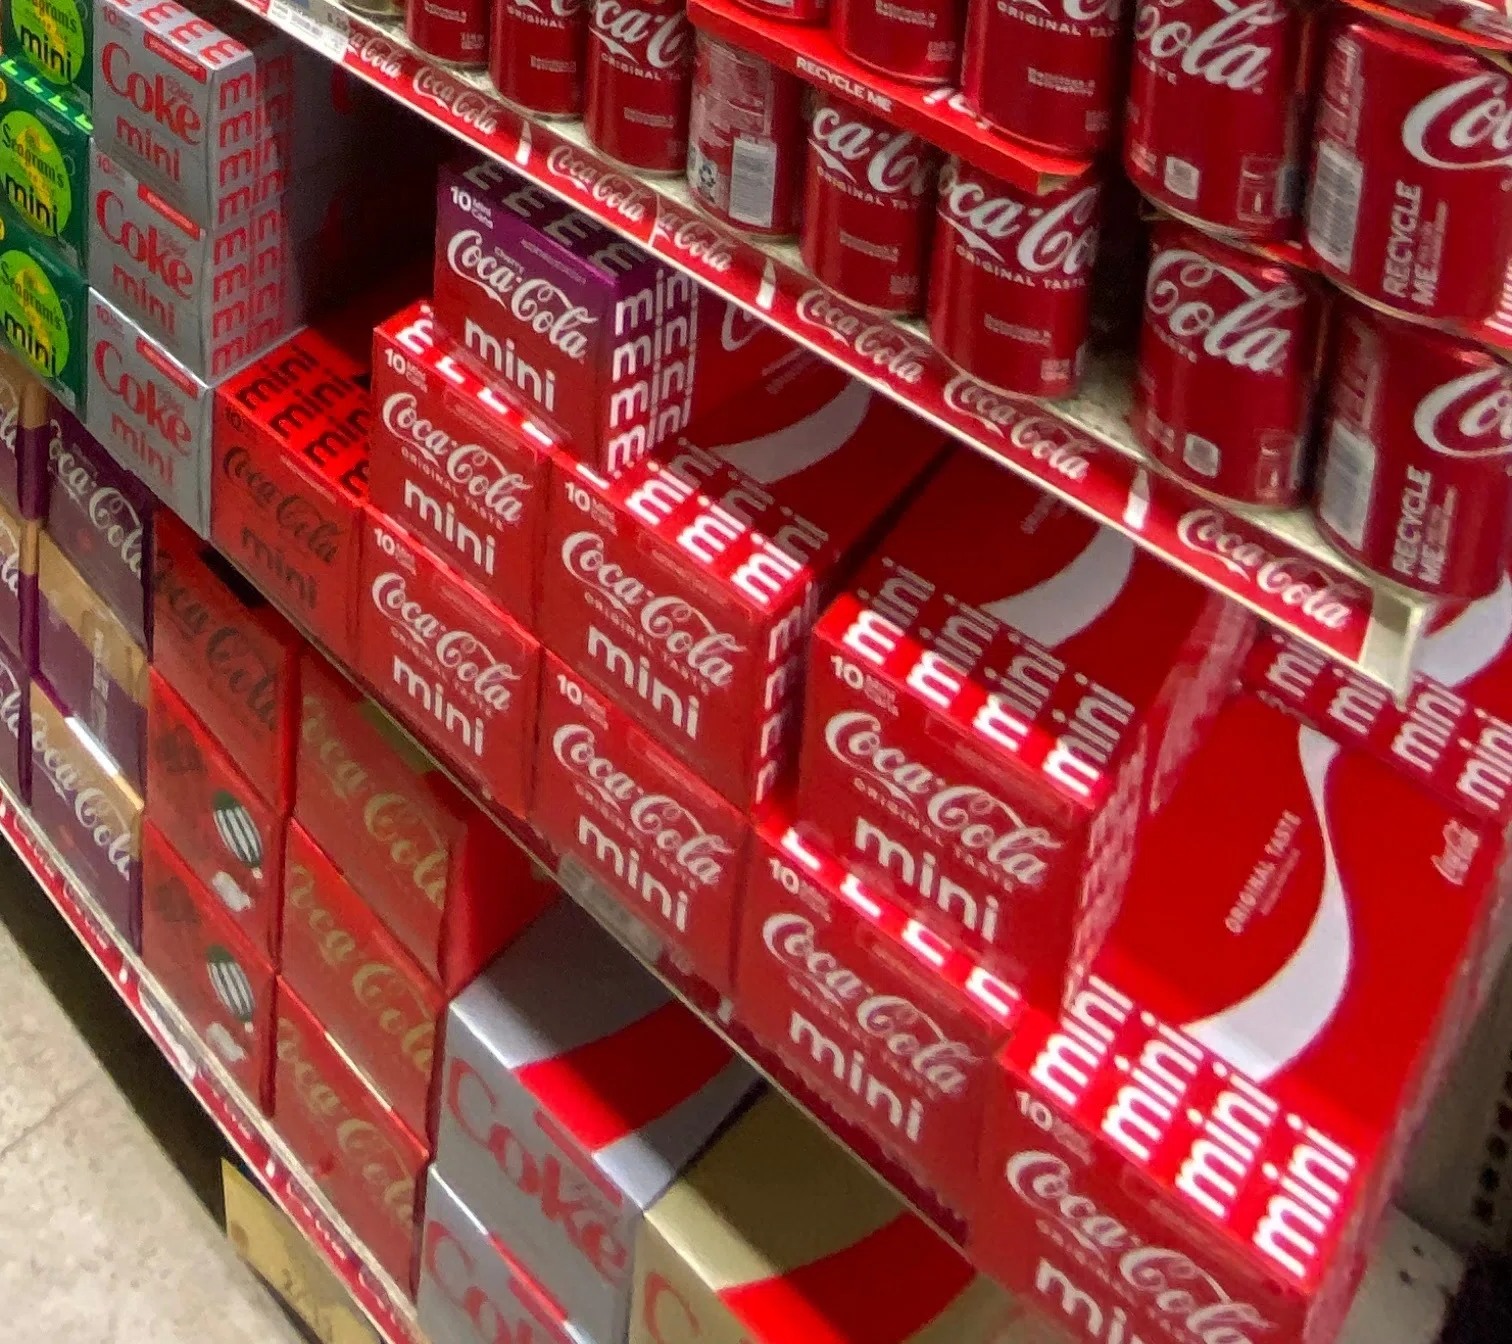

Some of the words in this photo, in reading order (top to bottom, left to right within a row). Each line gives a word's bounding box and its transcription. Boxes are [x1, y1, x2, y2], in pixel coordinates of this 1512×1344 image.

[19, 23, 73, 84] mini
[996, 0, 1083, 37] ORIGINAL
[101, 41, 203, 146] Coke
[794, 55, 866, 103] RECYCLE
[867, 90, 893, 112] ME
[115, 113, 181, 183] mini
[450, 186, 471, 213] 10
[5, 175, 60, 238] mini
[95, 188, 195, 301] Coke
[1383, 178, 1422, 299] RECYCLE
[4, 310, 58, 378] mini
[111, 262, 177, 337] mini
[447, 228, 598, 362] Coca-Cola
[94, 339, 194, 449] Coke
[384, 347, 407, 376] 10
[464, 316, 556, 413] mini
[382, 391, 532, 523] Coca-Cola
[564, 480, 591, 513] 10
[374, 527, 395, 555] 10
[404, 478, 497, 577] mini
[1392, 464, 1432, 575] RECYCLE
[371, 571, 521, 713] Coca-Cola
[561, 530, 748, 689] Coca-Cola
[393, 654, 485, 758] mini
[557, 673, 585, 707] 10
[587, 624, 700, 742] mini
[829, 655, 863, 690] 10
[552, 723, 736, 887] Coca-Cola
[825, 712, 1063, 888] Coca-Cola
[577, 815, 688, 934] mini
[768, 857, 801, 894] 10
[854, 816, 1000, 946] mini
[761, 913, 986, 1096] Coca-Cola
[1029, 974, 1134, 1108] mini
[790, 1010, 925, 1144] mini
[1015, 1090, 1054, 1131] 10
[1101, 1009, 1204, 1163] mini
[447, 1056, 631, 1286] Coke
[1175, 1060, 1279, 1221] mini
[1251, 1111, 1357, 1280] mini
